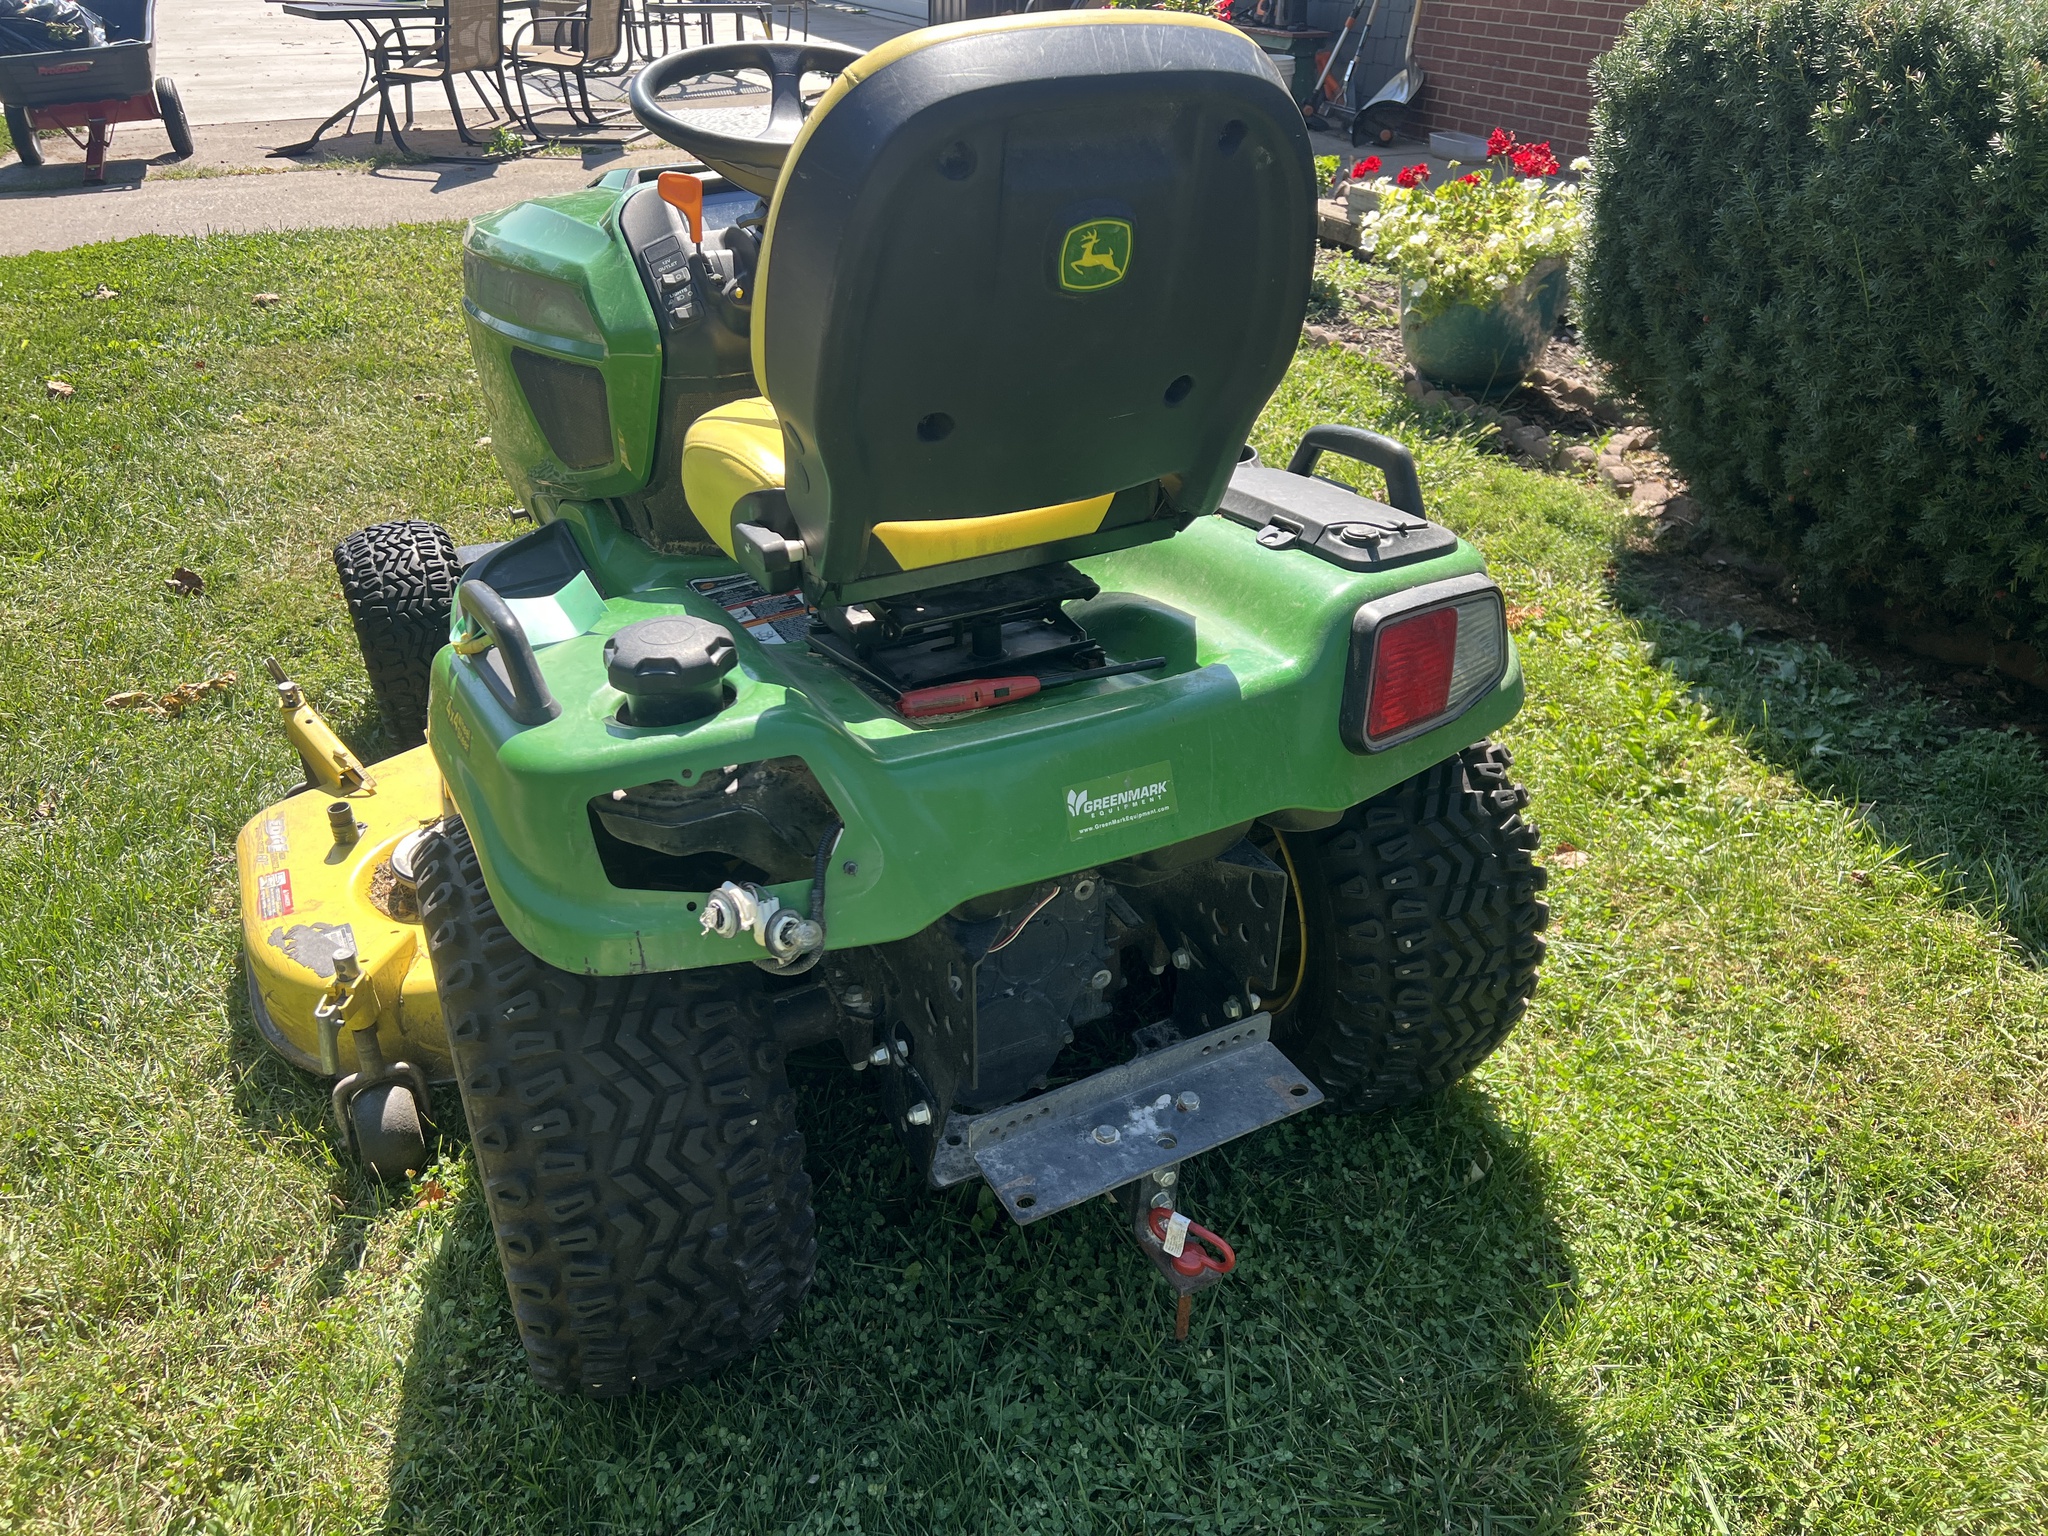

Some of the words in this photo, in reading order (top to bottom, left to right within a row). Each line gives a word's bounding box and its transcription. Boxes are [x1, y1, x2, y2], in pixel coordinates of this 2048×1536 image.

[658, 261, 678, 272] OUTLET
[669, 287, 688, 298] LIGHTS
[1083, 781, 1167, 814] GREENMARK
[1091, 795, 1162, 818] EQUIPMENT
[1079, 806, 1170, 834] www.GreenMarkEquipment.com
